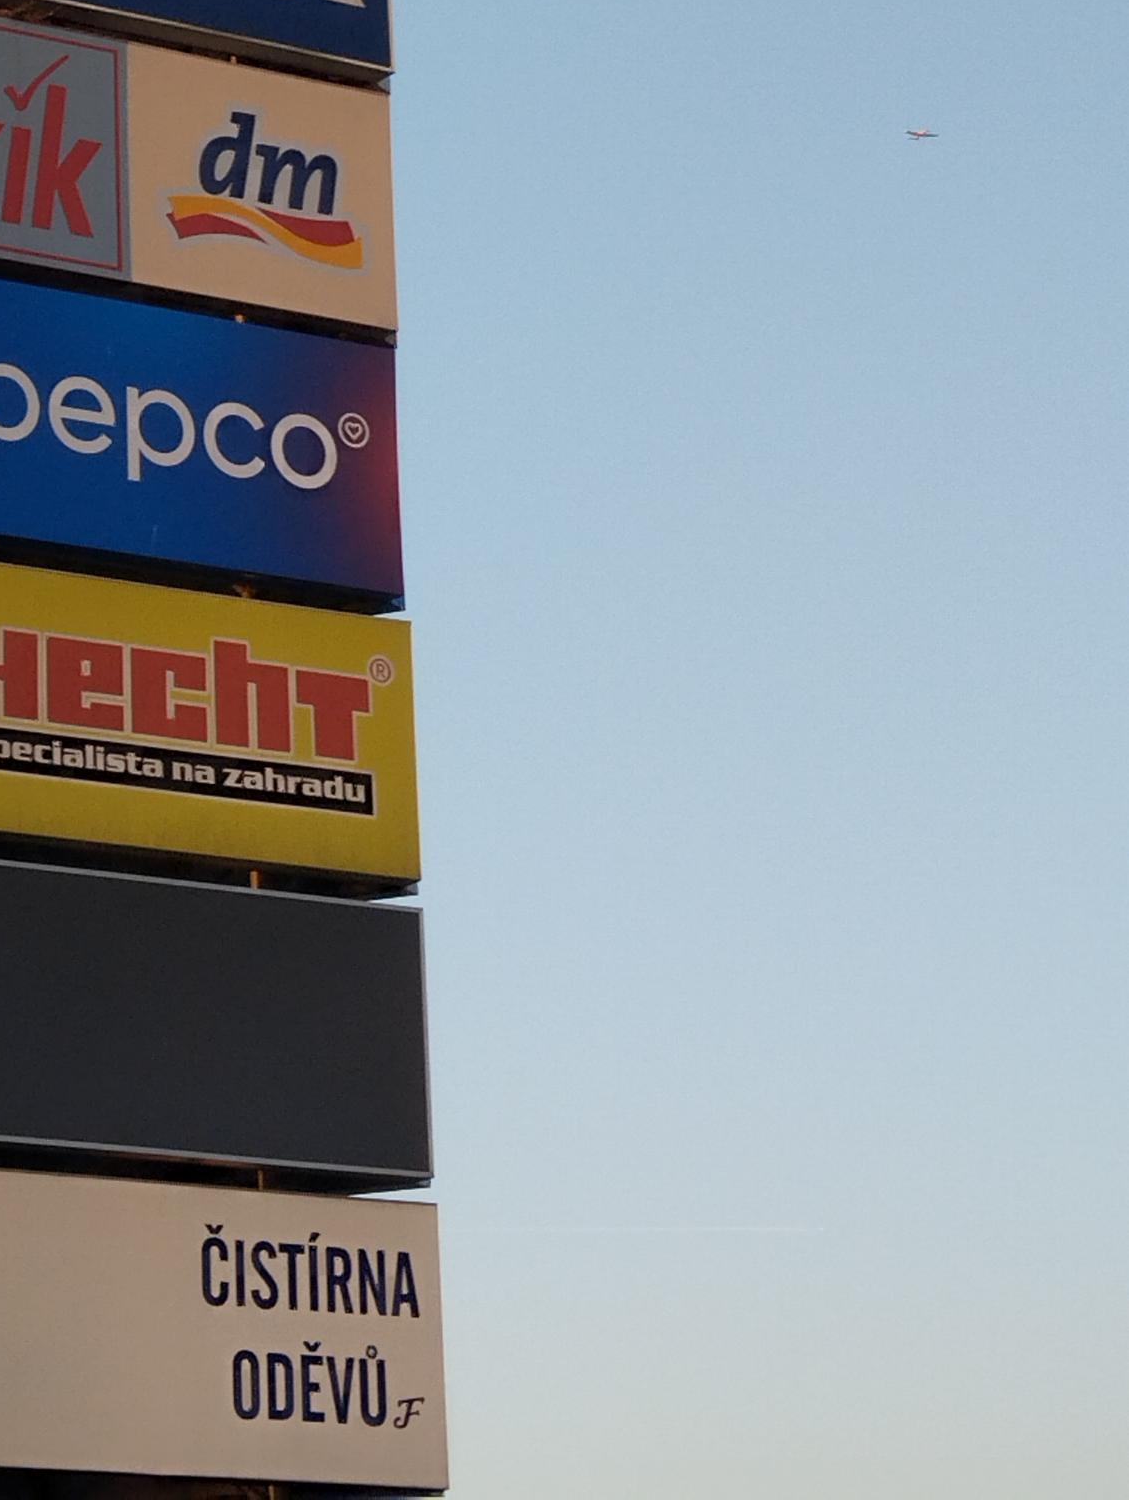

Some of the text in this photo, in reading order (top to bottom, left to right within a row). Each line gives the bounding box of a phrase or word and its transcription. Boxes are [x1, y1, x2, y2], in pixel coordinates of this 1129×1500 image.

[198, 111, 339, 216] dm
[172, 762, 216, 786] na
[223, 766, 366, 804] zahradu
[201, 1224, 420, 1319] ČISTÍRNA
[232, 1341, 387, 1428] ODĚVŮ
